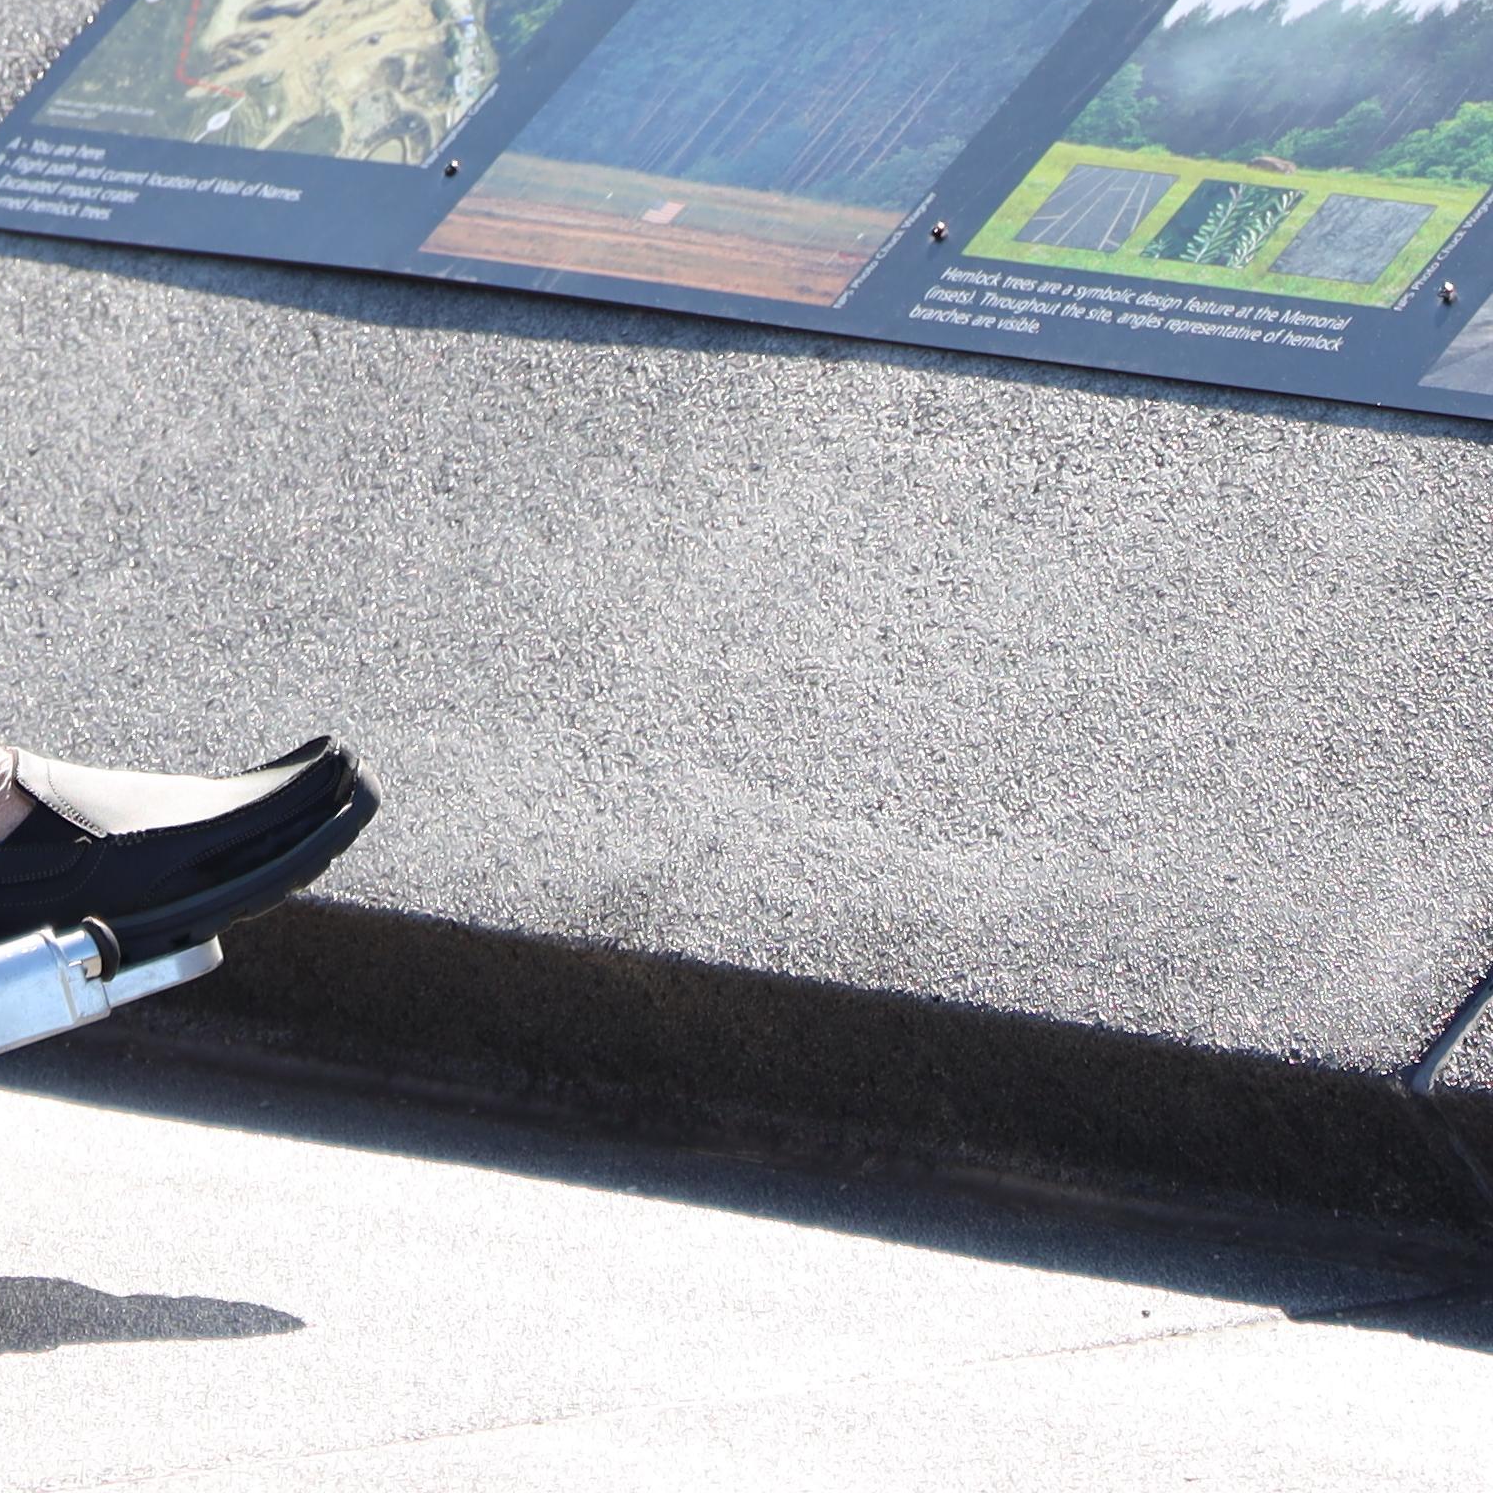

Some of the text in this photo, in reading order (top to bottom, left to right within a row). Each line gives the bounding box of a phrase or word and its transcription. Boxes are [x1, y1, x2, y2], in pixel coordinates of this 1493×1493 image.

[5, 136, 21, 150] A
[30, 138, 54, 155] You
[52, 144, 77, 158] are
[43, 163, 77, 177] path
[75, 166, 107, 180] and
[101, 170, 149, 186] current
[146, 171, 197, 190] location
[196, 177, 216, 192] of
[213, 178, 246, 195] Wall
[241, 182, 262, 197] of
[940, 266, 1353, 331] Hemlock trees are a symbolic design feature at the Memorial
[909, 303, 1042, 334] branches are visible.
[924, 284, 1345, 352] (insets). Throughout the site, angles representative of hemlock
